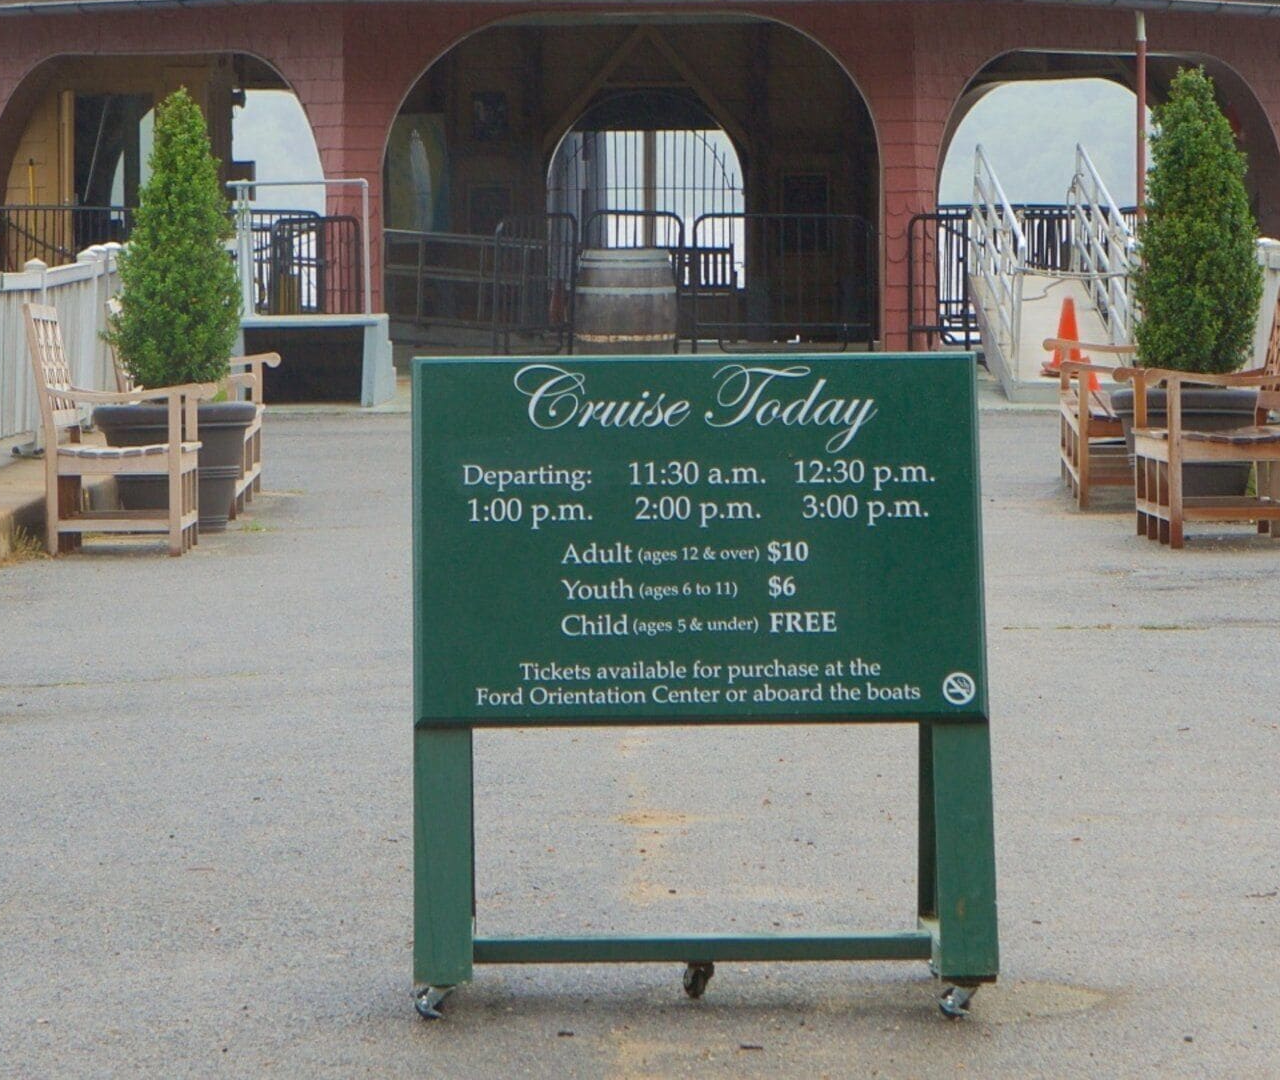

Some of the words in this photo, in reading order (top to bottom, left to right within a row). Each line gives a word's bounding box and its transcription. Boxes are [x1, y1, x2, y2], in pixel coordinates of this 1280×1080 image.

[514, 363, 691, 430] Cruise
[705, 363, 878, 454] Today
[462, 464, 592, 492] Departing:
[628, 461, 700, 485] 11:30
[708, 467, 766, 484] a.m.
[794, 459, 865, 483] 12:30
[873, 465, 935, 491] p.m.
[467, 498, 523, 522] 1:00
[531, 503, 593, 529] p.m.
[635, 496, 691, 520] 2:00
[699, 501, 761, 528] p.m.
[802, 494, 858, 519] 3:00
[866, 500, 929, 526] p.m.
[561, 542, 632, 564] Adult
[637, 548, 678, 565] (ages
[682, 546, 698, 560] 12
[703, 546, 716, 560] &
[720, 546, 760, 561] over)
[767, 540, 809, 564] $10
[561, 577, 634, 600] Youth
[638, 583, 679, 600] (ages
[682, 582, 692, 595] 6
[695, 583, 711, 595] to
[715, 581, 738, 597] 11)
[768, 575, 796, 598] $6
[561, 613, 628, 636] Child
[632, 618, 673, 635] (ages
[678, 618, 687, 633] 5
[689, 617, 703, 631] &
[707, 616, 759, 633] under)
[769, 611, 837, 633] FREE
[519, 662, 591, 681] Tickets
[596, 660, 687, 679] available
[693, 659, 722, 678] for
[727, 658, 821, 683] purchase
[824, 662, 845, 677] at
[849, 658, 881, 677] the
[475, 686, 523, 705] Ford
[529, 686, 646, 705] Orientation
[651, 684, 721, 703] Center
[725, 689, 748, 702] or
[753, 682, 823, 702] aboard
[829, 682, 861, 701] the
[866, 681, 921, 700] boats
